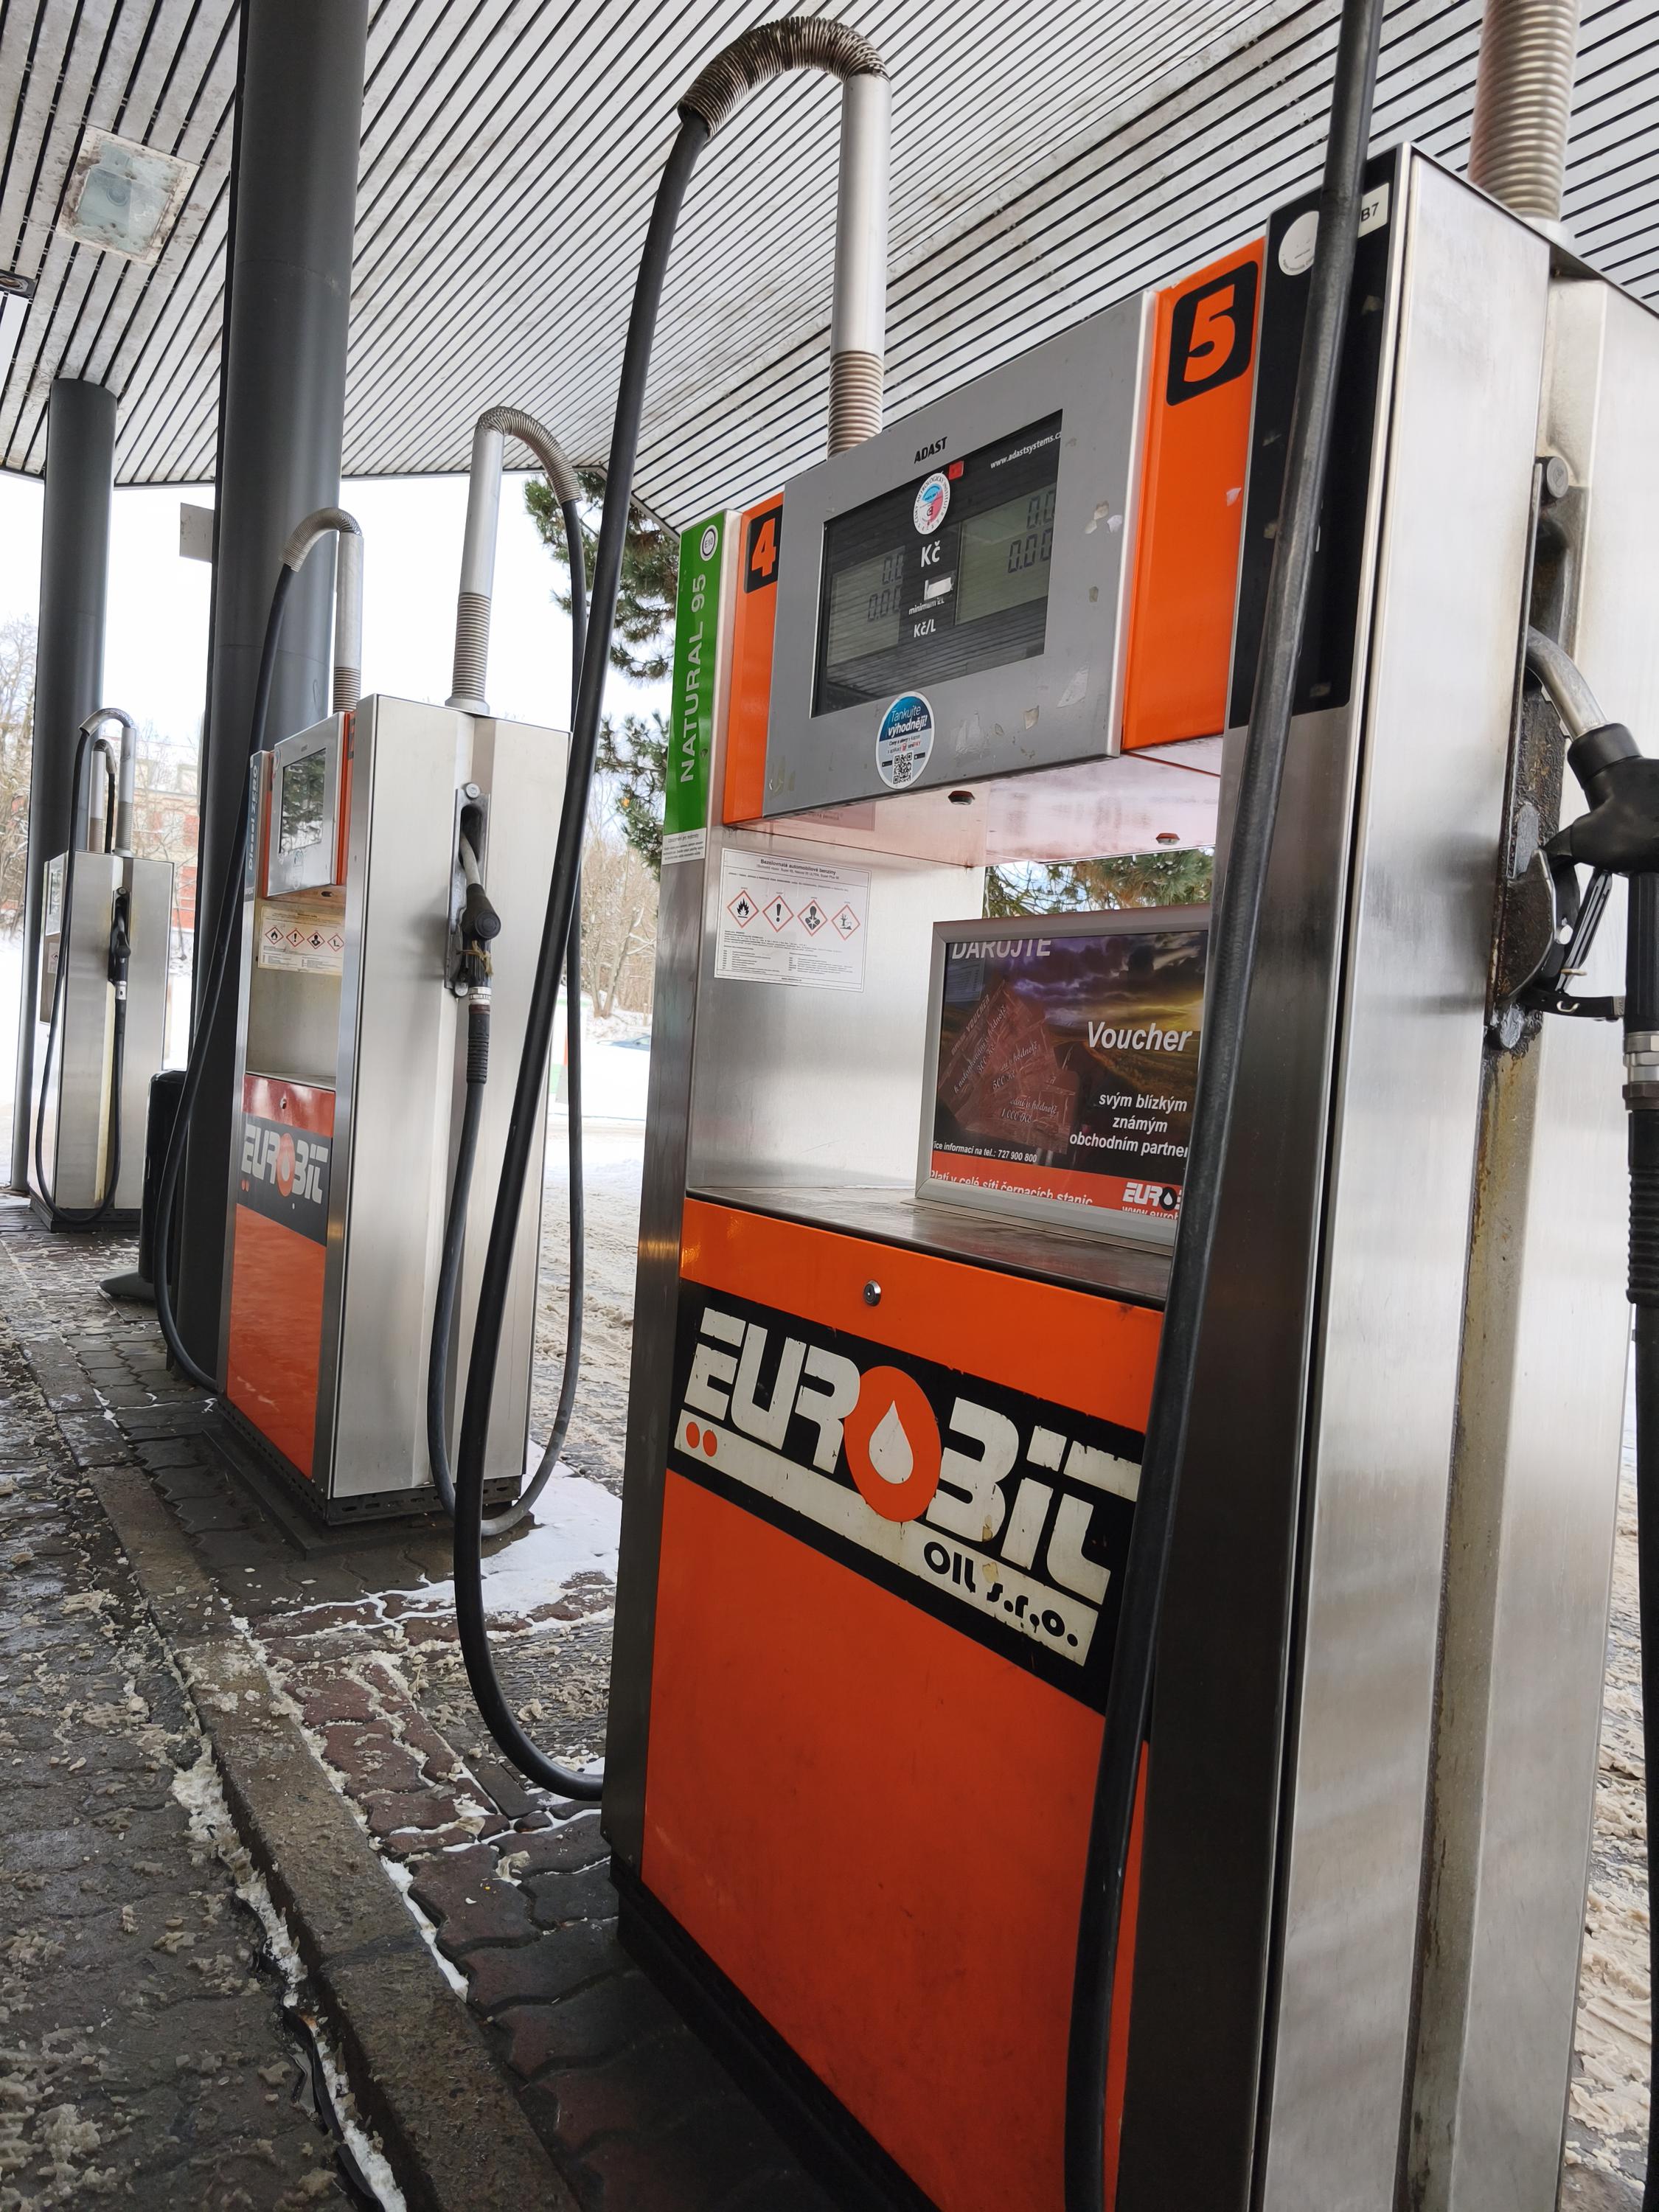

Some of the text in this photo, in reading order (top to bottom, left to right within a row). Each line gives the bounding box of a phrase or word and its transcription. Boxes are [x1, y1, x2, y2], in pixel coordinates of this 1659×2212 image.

[1360, 201, 1380, 223] B7
[1183, 283, 1236, 383] 5
[914, 437, 947, 464] ADAST
[990, 431, 1062, 470] www.adastsystems.c
[704, 537, 714, 549] E10
[751, 518, 776, 577] 4
[920, 540, 941, 568] Kč
[914, 619, 936, 639] Kč/L
[680, 574, 706, 783] NATURAL 95
[888, 714, 928, 738] výhodněji!
[891, 706, 921, 723] Tankujte
[1088, 1020, 1193, 1052] Voucher
[1099, 1091, 1188, 1115] svým blízkým
[1112, 1114, 1168, 1135] známým
[933, 1141, 943, 1150] íce
[944, 1143, 974, 1154] informací
[984, 1147, 996, 1157] tel.:
[998, 1149, 1009, 1159] 727
[1010, 1152, 1023, 1161] 900
[1024, 1153, 1037, 1163] 800
[1069, 1130, 1139, 1152] obchodním
[923, 1541, 1079, 1648] OIL s.r.o.
